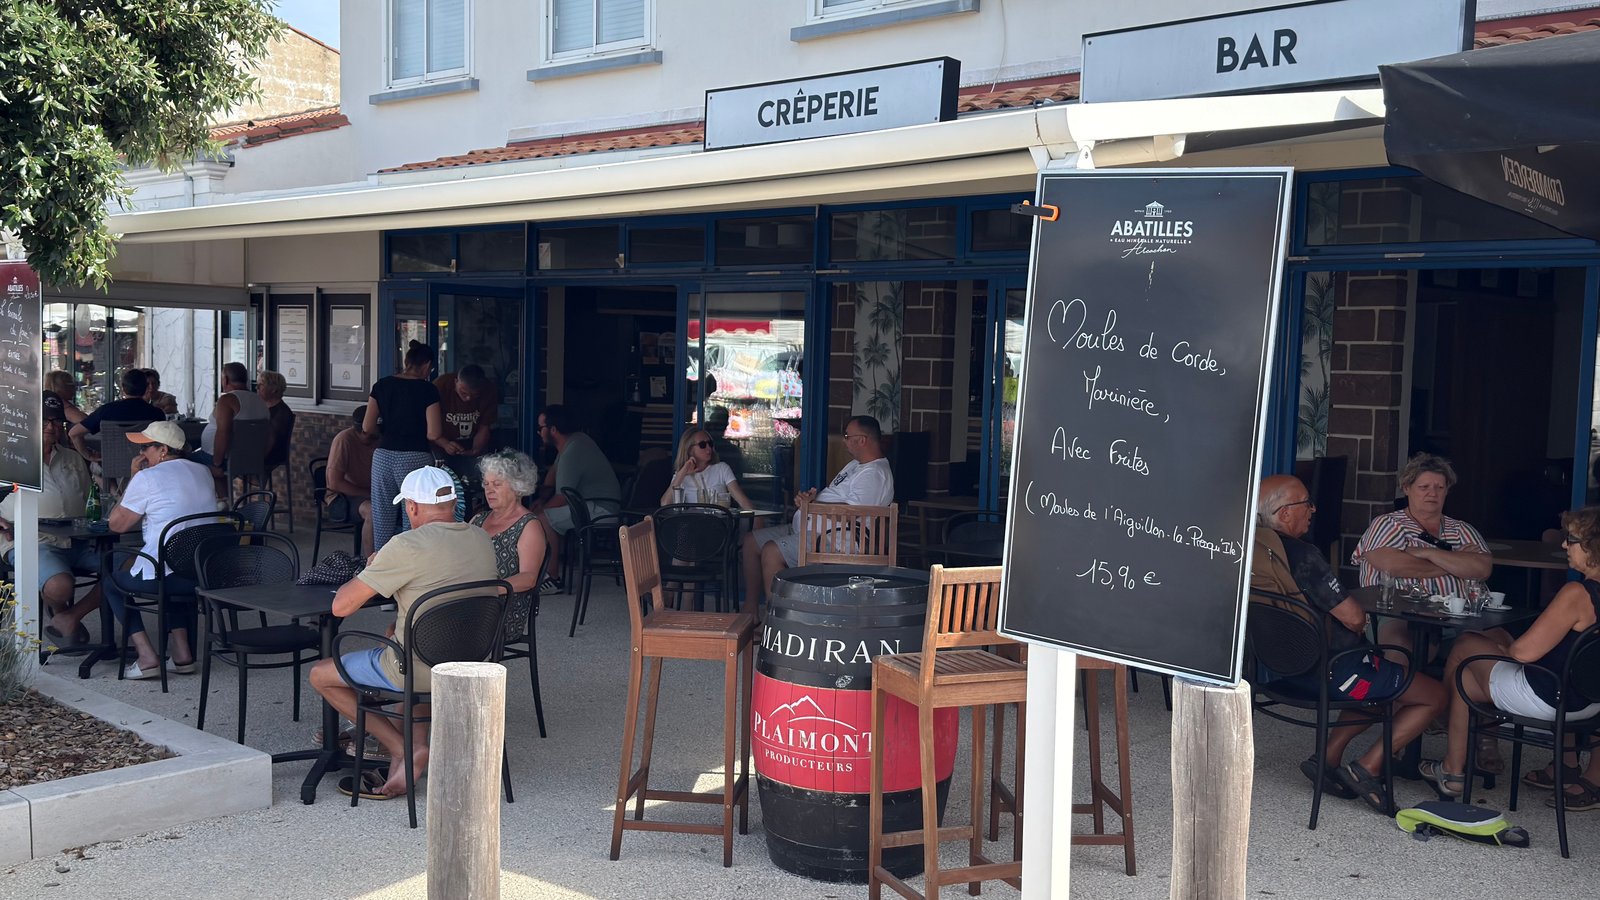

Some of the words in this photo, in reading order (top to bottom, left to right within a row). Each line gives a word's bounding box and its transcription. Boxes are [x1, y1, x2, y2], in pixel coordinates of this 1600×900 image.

[1216, 28, 1298, 74] BAR
[757, 87, 880, 128] CRÊPERIE
[1110, 220, 1194, 238] ABATILLES
[1047, 298, 1125, 352] Moules
[1139, 331, 1158, 360] de
[1171, 340, 1226, 375] Corde,
[1051, 426, 1091, 461] Avec
[1109, 439, 1150, 476] Frites
[1083, 502, 1097, 520] de
[1075, 558, 1135, 590] 15,90
[1143, 571, 1162, 586] €
[760, 624, 901, 665] MADIRAN
[765, 749, 853, 772] PRODUCTEURS
